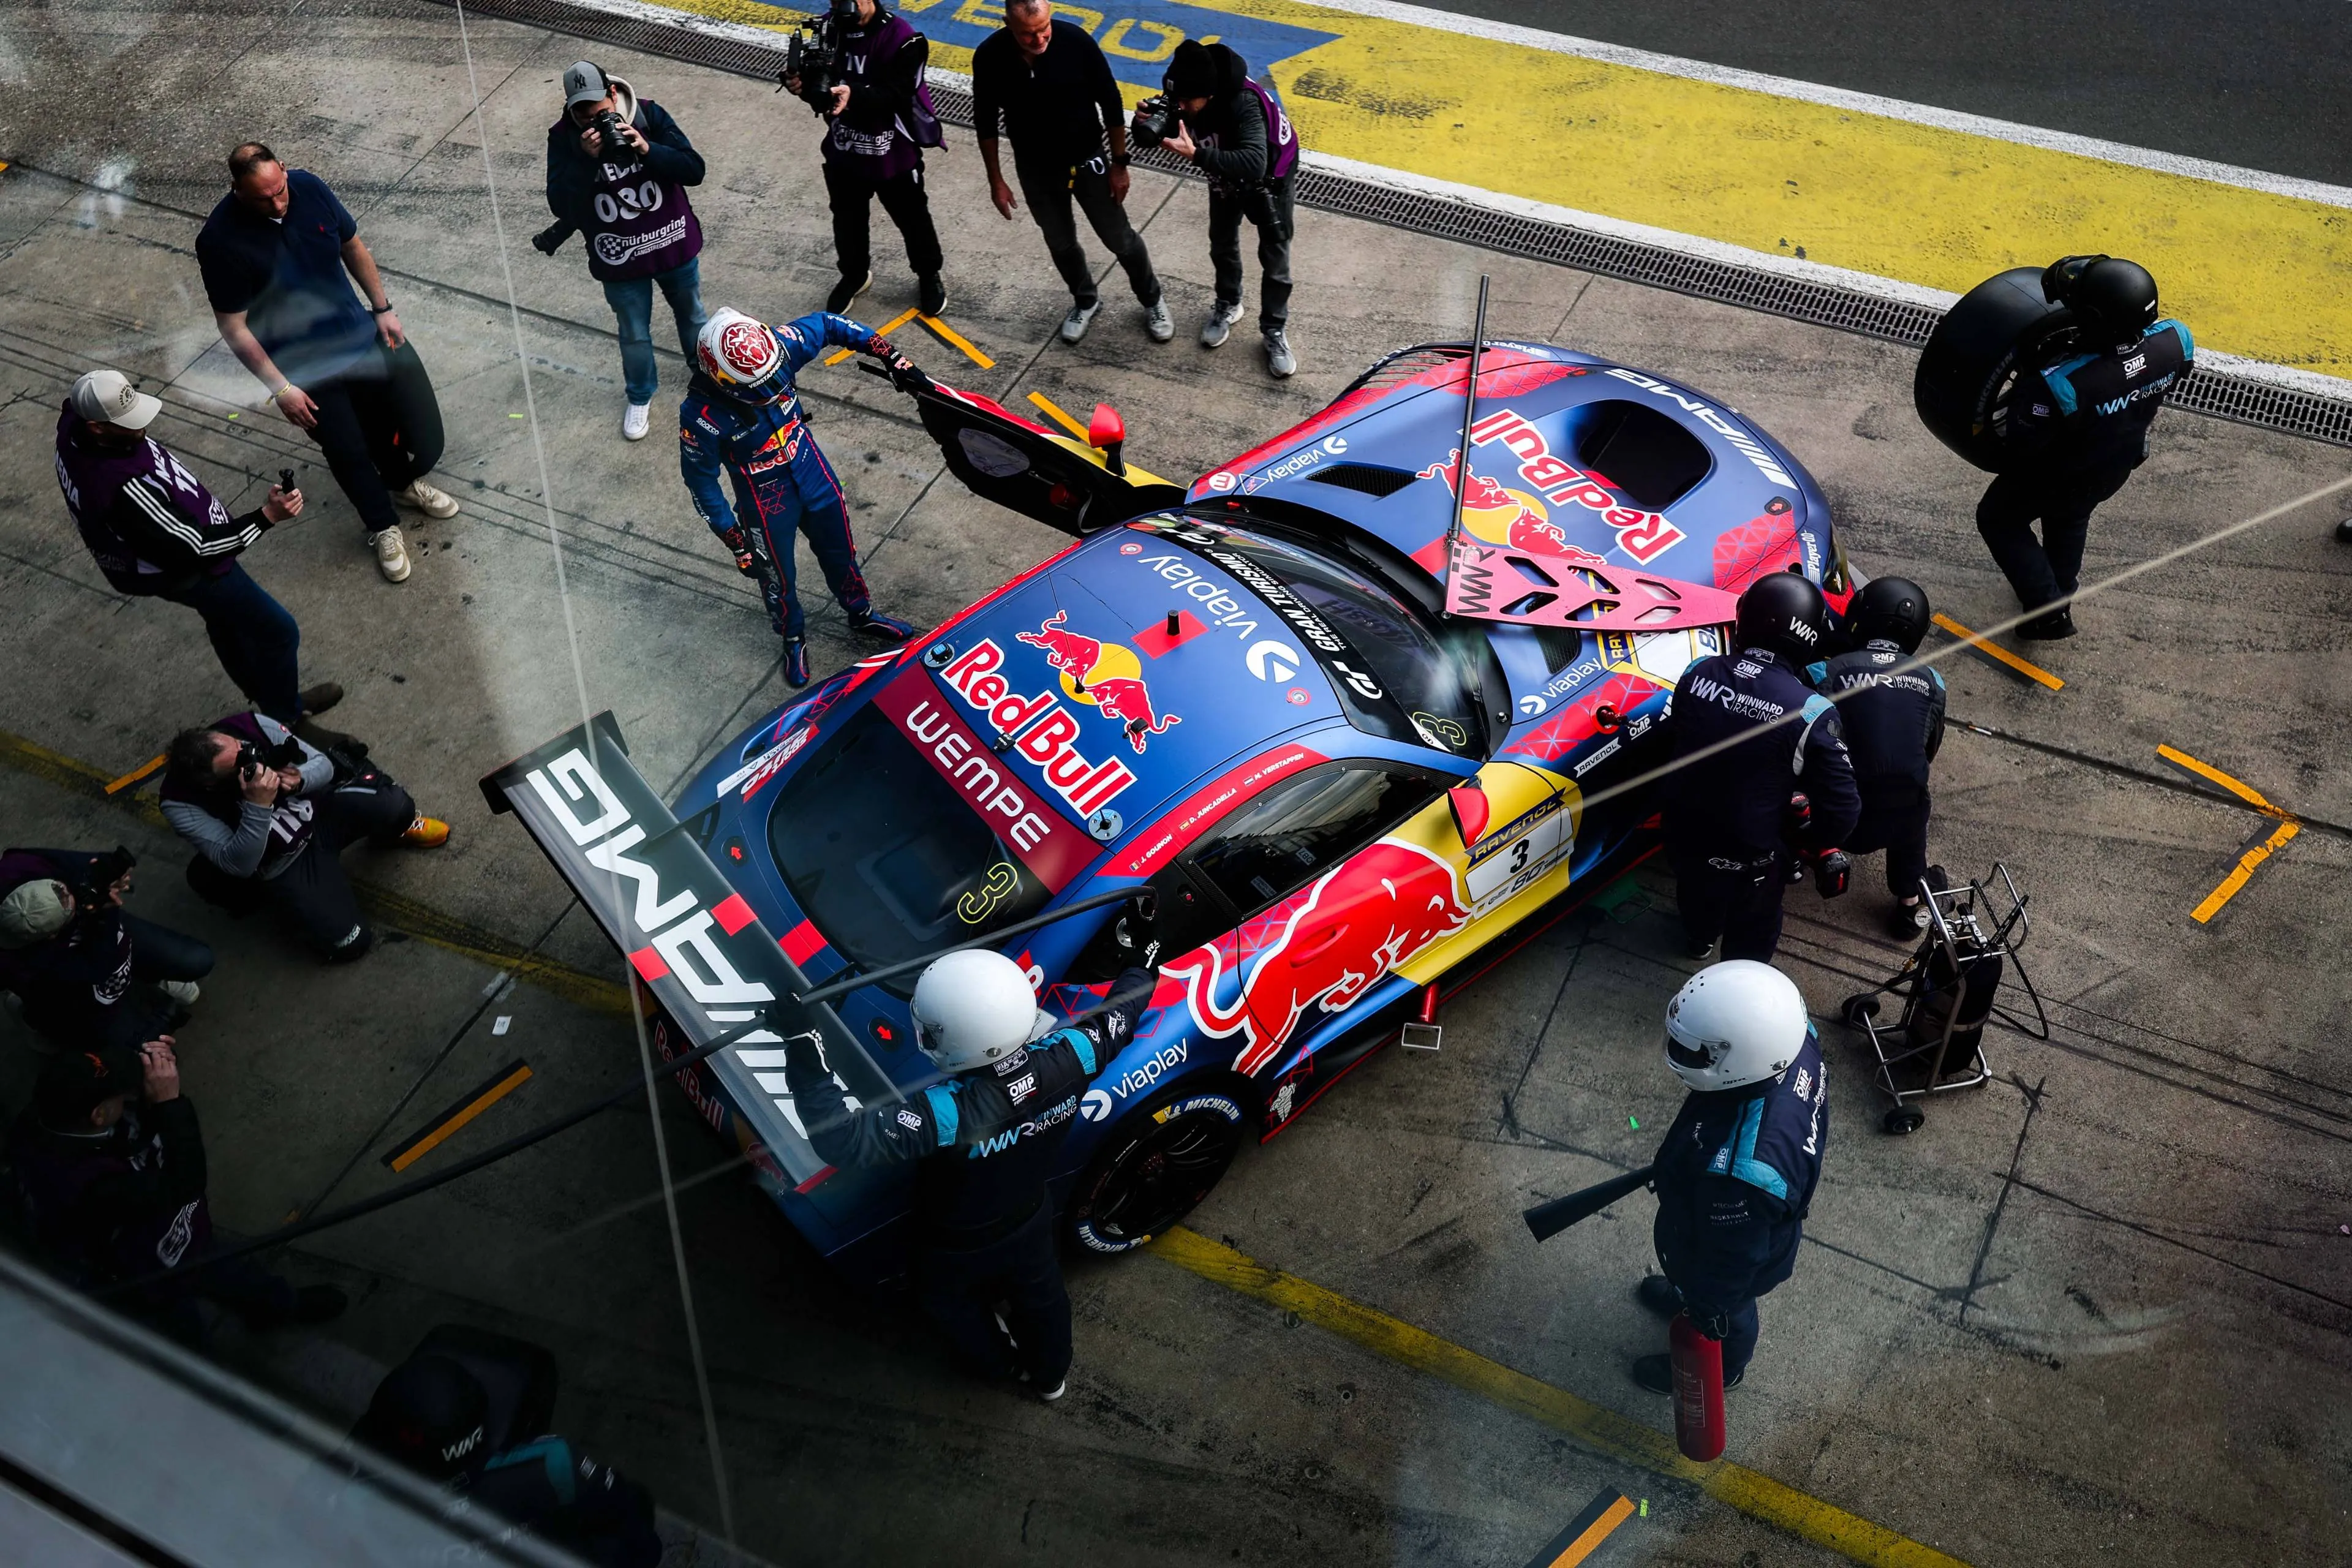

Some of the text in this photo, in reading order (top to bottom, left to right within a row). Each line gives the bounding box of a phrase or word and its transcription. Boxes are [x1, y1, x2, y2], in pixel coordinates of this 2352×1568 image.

[594, 181, 663, 223] 080
[2124, 356, 2146, 372] OMP
[2140, 380, 2174, 399] RACING
[696, 417, 720, 435] sparco
[748, 448, 789, 475] Red
[1267, 447, 1319, 483] viaplay
[1457, 409, 1687, 566] Red Bull
[1232, 552, 1279, 586] SIMULATOR
[1138, 552, 1259, 640] viaplay
[1278, 586, 1311, 613] DRIVING
[1283, 608, 1340, 652] GRAN
[1311, 613, 1332, 633] REAL
[1330, 634, 1347, 650] THE
[1736, 662, 1762, 676] OMP
[1872, 653, 1896, 663] OMP
[1542, 657, 1603, 698] viaplay
[1894, 675, 1929, 690] WINWARD
[1897, 681, 1930, 697] RACING
[1733, 703, 1779, 725] RACING
[1738, 693, 1784, 716] WINWARD
[940, 638, 1137, 820] Red Bull
[1412, 710, 1467, 746] 3
[1262, 752, 1305, 778] VERSTAPPEN
[1579, 741, 1618, 772] RAVENOL
[907, 700, 1051, 852] WEMPE
[1196, 787, 1238, 820] JUNCADELLA
[1474, 801, 1556, 860] RAVENOL
[1145, 833, 1173, 859] GOUNON
[1510, 839, 1530, 873] 3
[957, 862, 1018, 924] 3
[1112, 1038, 1188, 1100] viaplay
[1009, 1076, 1035, 1098] OMP
[897, 1111, 921, 1129] OMP
[1037, 1103, 1077, 1133] RACING
[1185, 1097, 1240, 1121] MICHELIN
[1078, 1224, 1129, 1253] MICHELIN
